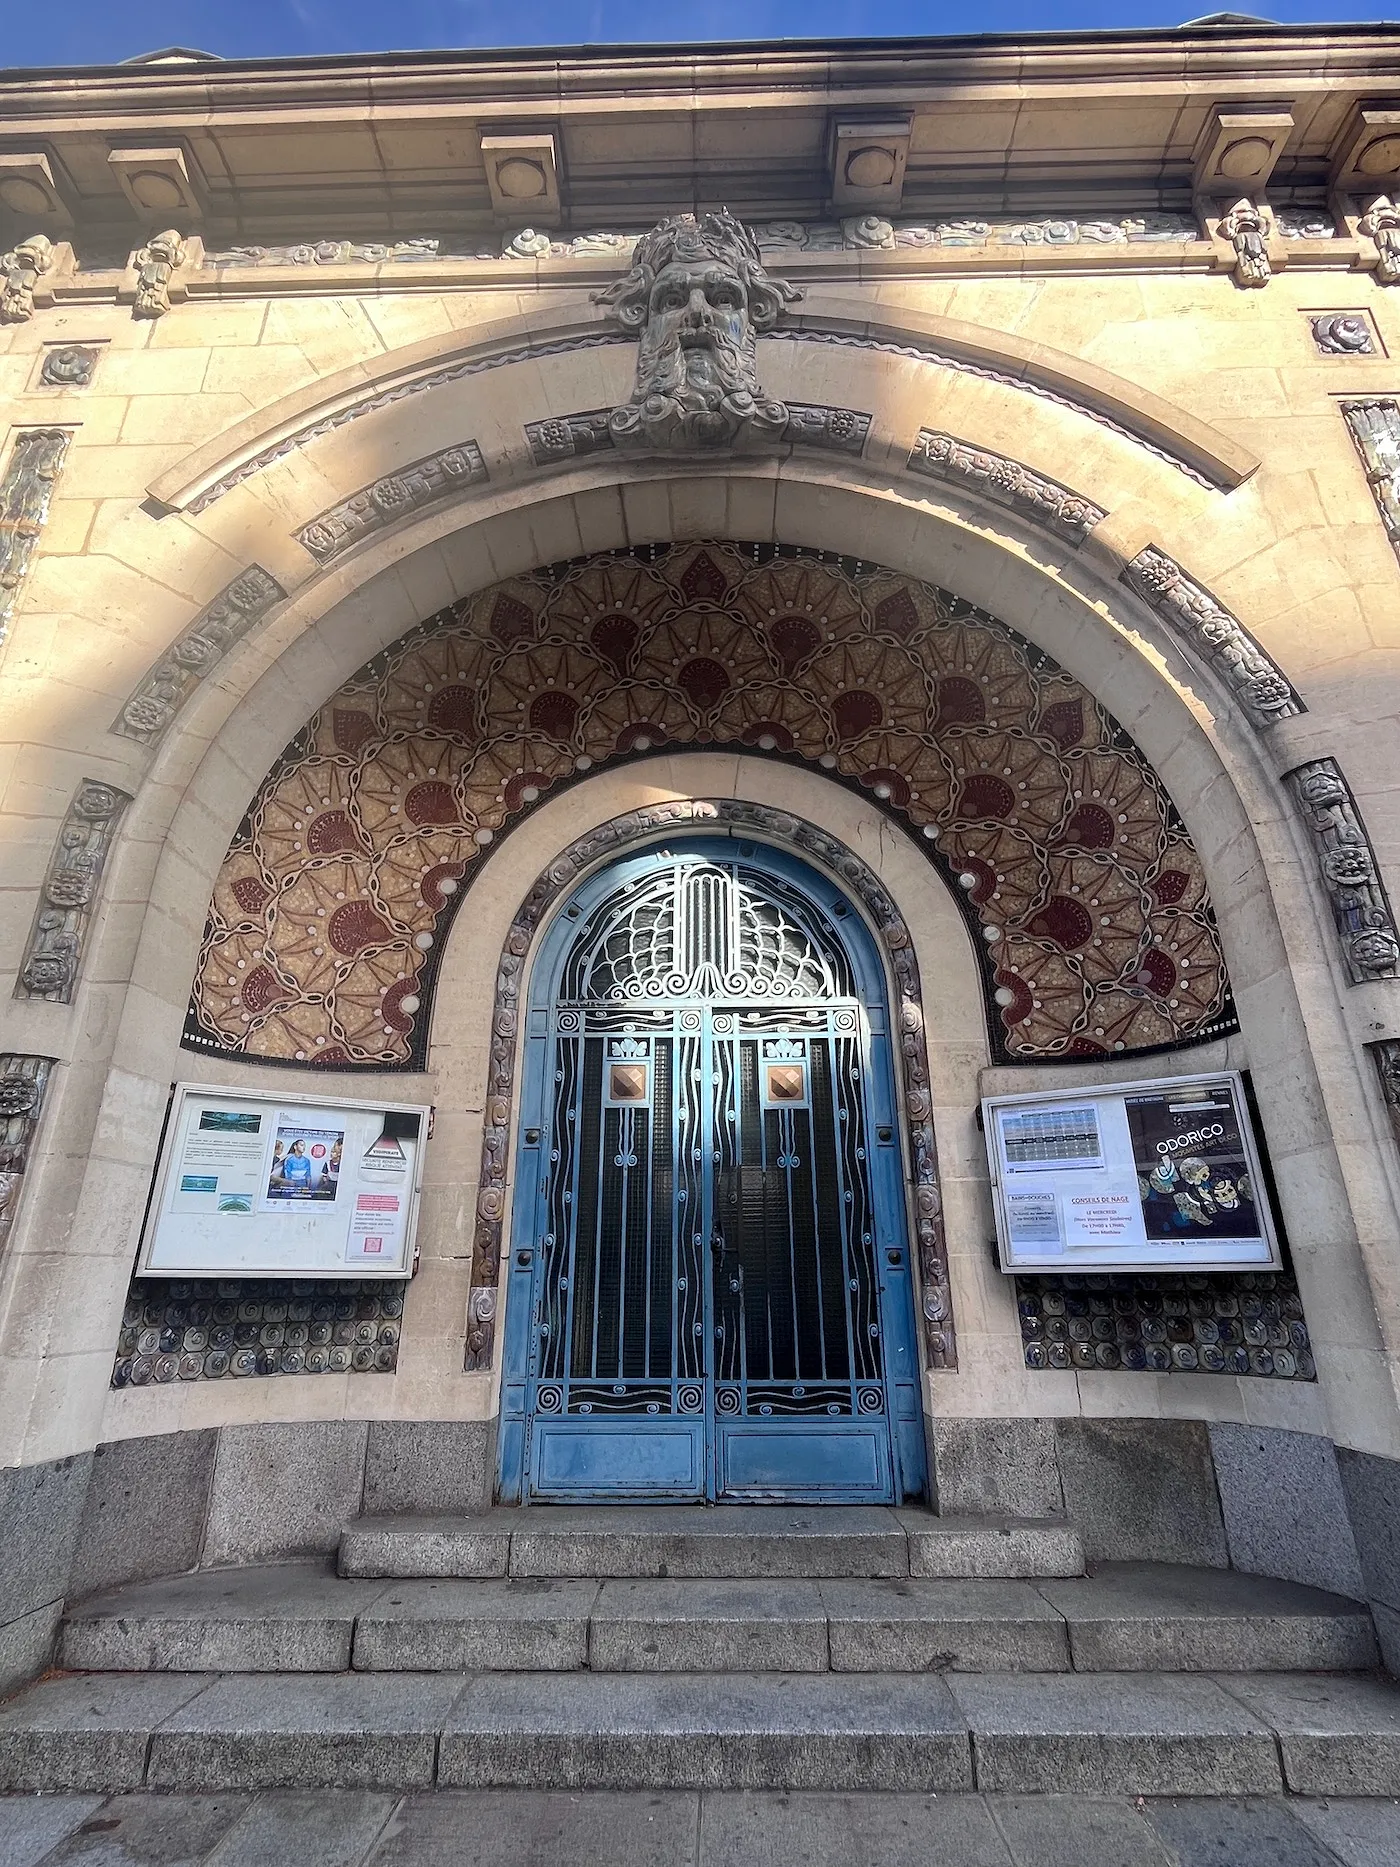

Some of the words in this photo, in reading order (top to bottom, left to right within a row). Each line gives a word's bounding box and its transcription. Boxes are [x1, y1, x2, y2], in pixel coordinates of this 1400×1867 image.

[1156, 1123, 1224, 1154] ODORICO
[1205, 1138, 1218, 1148] ART
[1071, 1197, 1101, 1205] CONSEILS
[1101, 1196, 1111, 1204] DE
[1111, 1195, 1130, 1204] NAGE
